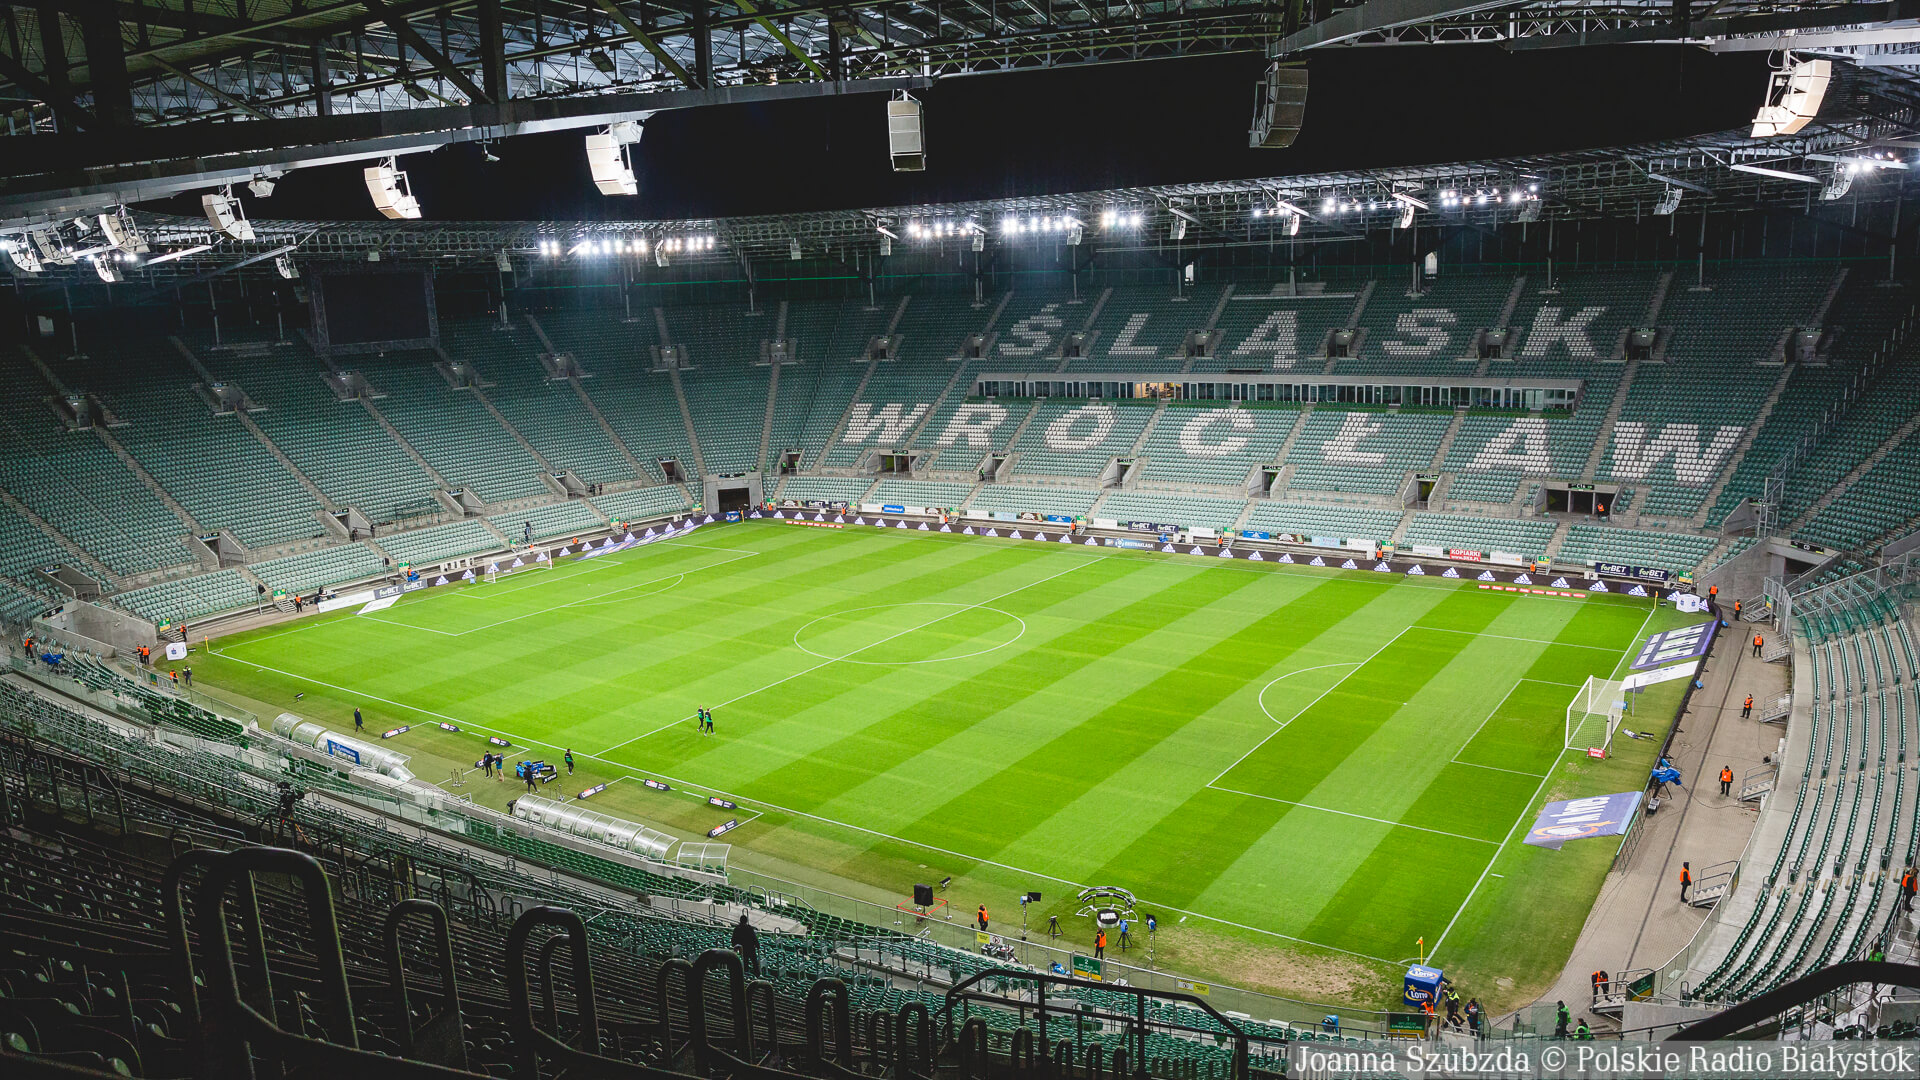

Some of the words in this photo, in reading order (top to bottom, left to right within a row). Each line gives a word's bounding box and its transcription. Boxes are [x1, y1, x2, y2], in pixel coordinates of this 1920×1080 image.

[842, 402, 1745, 483] WROCŁAW
[1451, 549, 1481, 557] KOPIARKI
[1600, 565, 1627, 573] forBET
[1638, 568, 1665, 577] forBET
[1410, 990, 1429, 999] LOTTO
